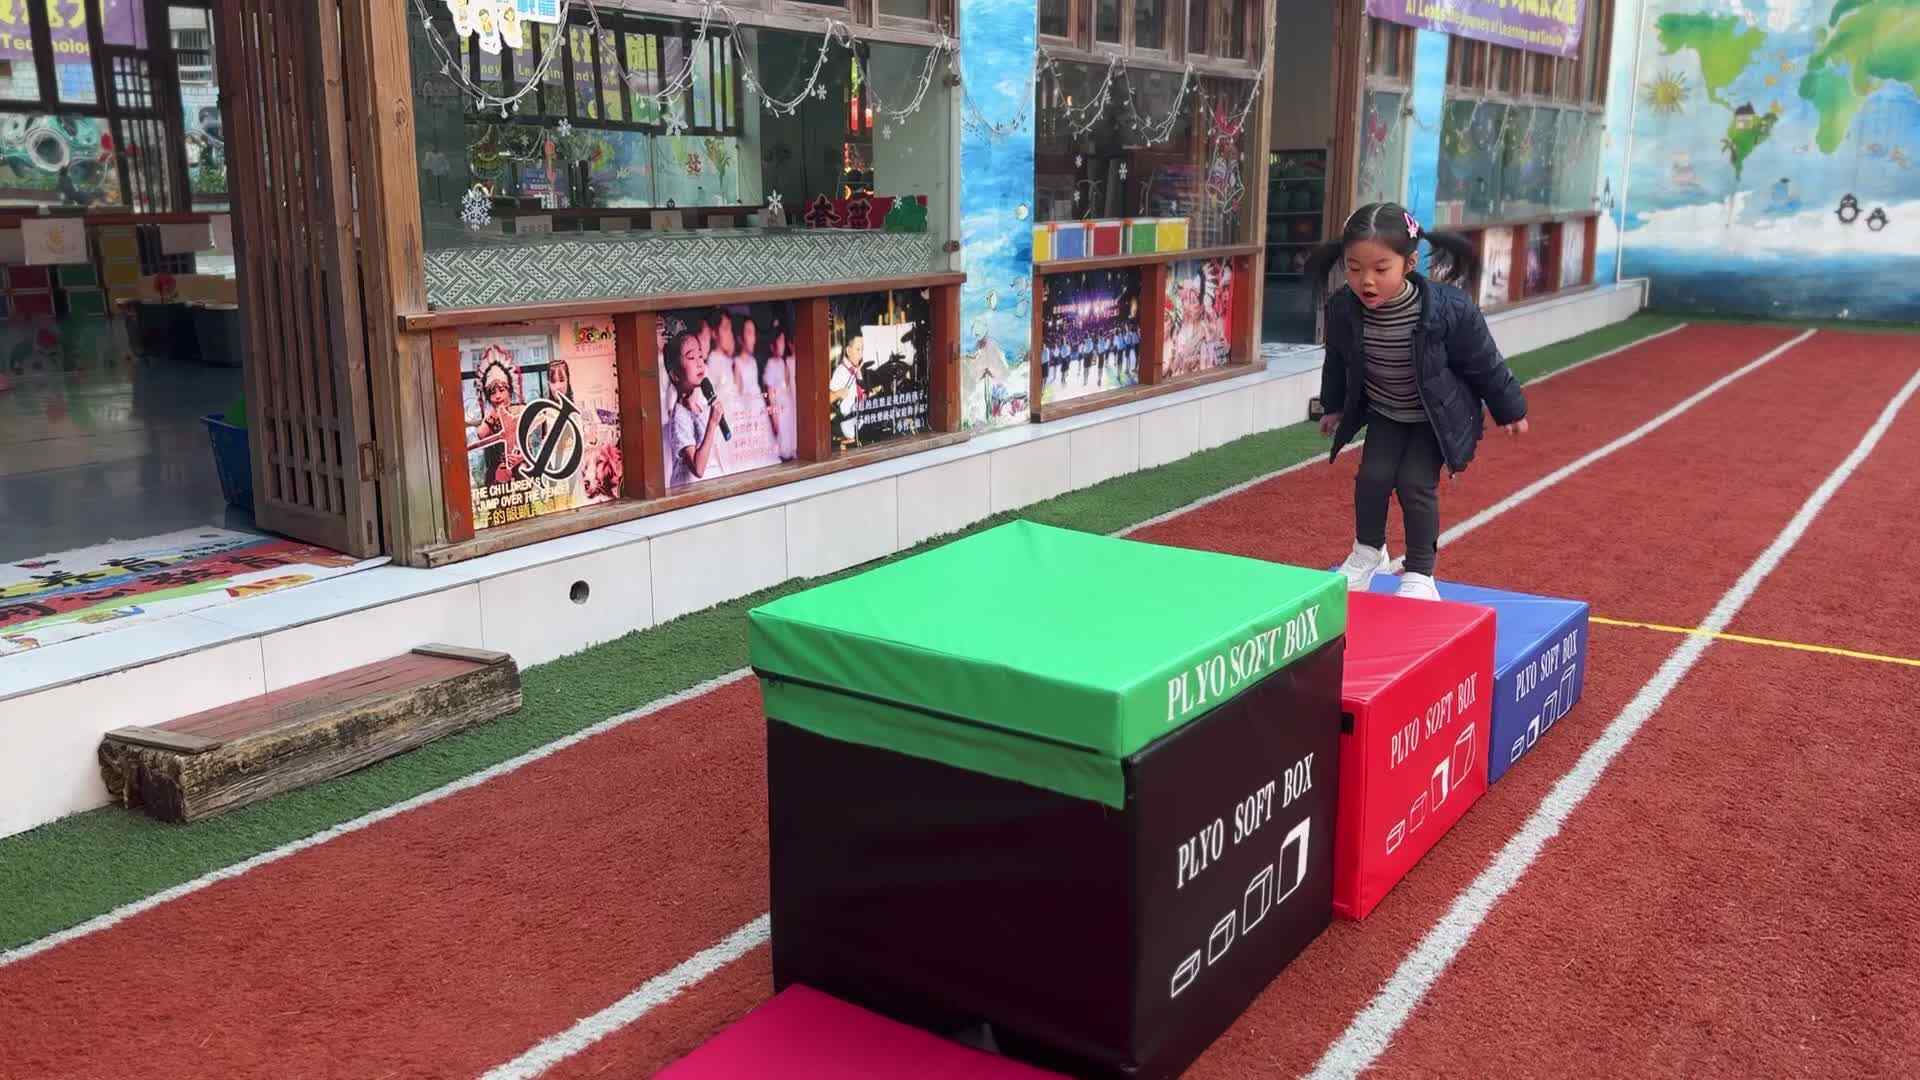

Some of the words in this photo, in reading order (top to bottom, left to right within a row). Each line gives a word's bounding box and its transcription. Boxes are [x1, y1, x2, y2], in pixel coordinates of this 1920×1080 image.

[501, 494, 523, 506] OVER
[1167, 655, 1226, 721] PLYO
[1230, 626, 1282, 689] SOFT
[1282, 603, 1320, 660] BOX
[1516, 661, 1537, 702] PLYO
[1540, 643, 1560, 682] SOFT
[1562, 628, 1578, 664] BOX
[1391, 717, 1419, 770] PLYO
[1425, 691, 1454, 740] SOFT
[1458, 671, 1477, 715] BOX
[1177, 818, 1224, 889] PLYO
[1234, 780, 1275, 845] SOFT
[1282, 752, 1314, 809] BOX
